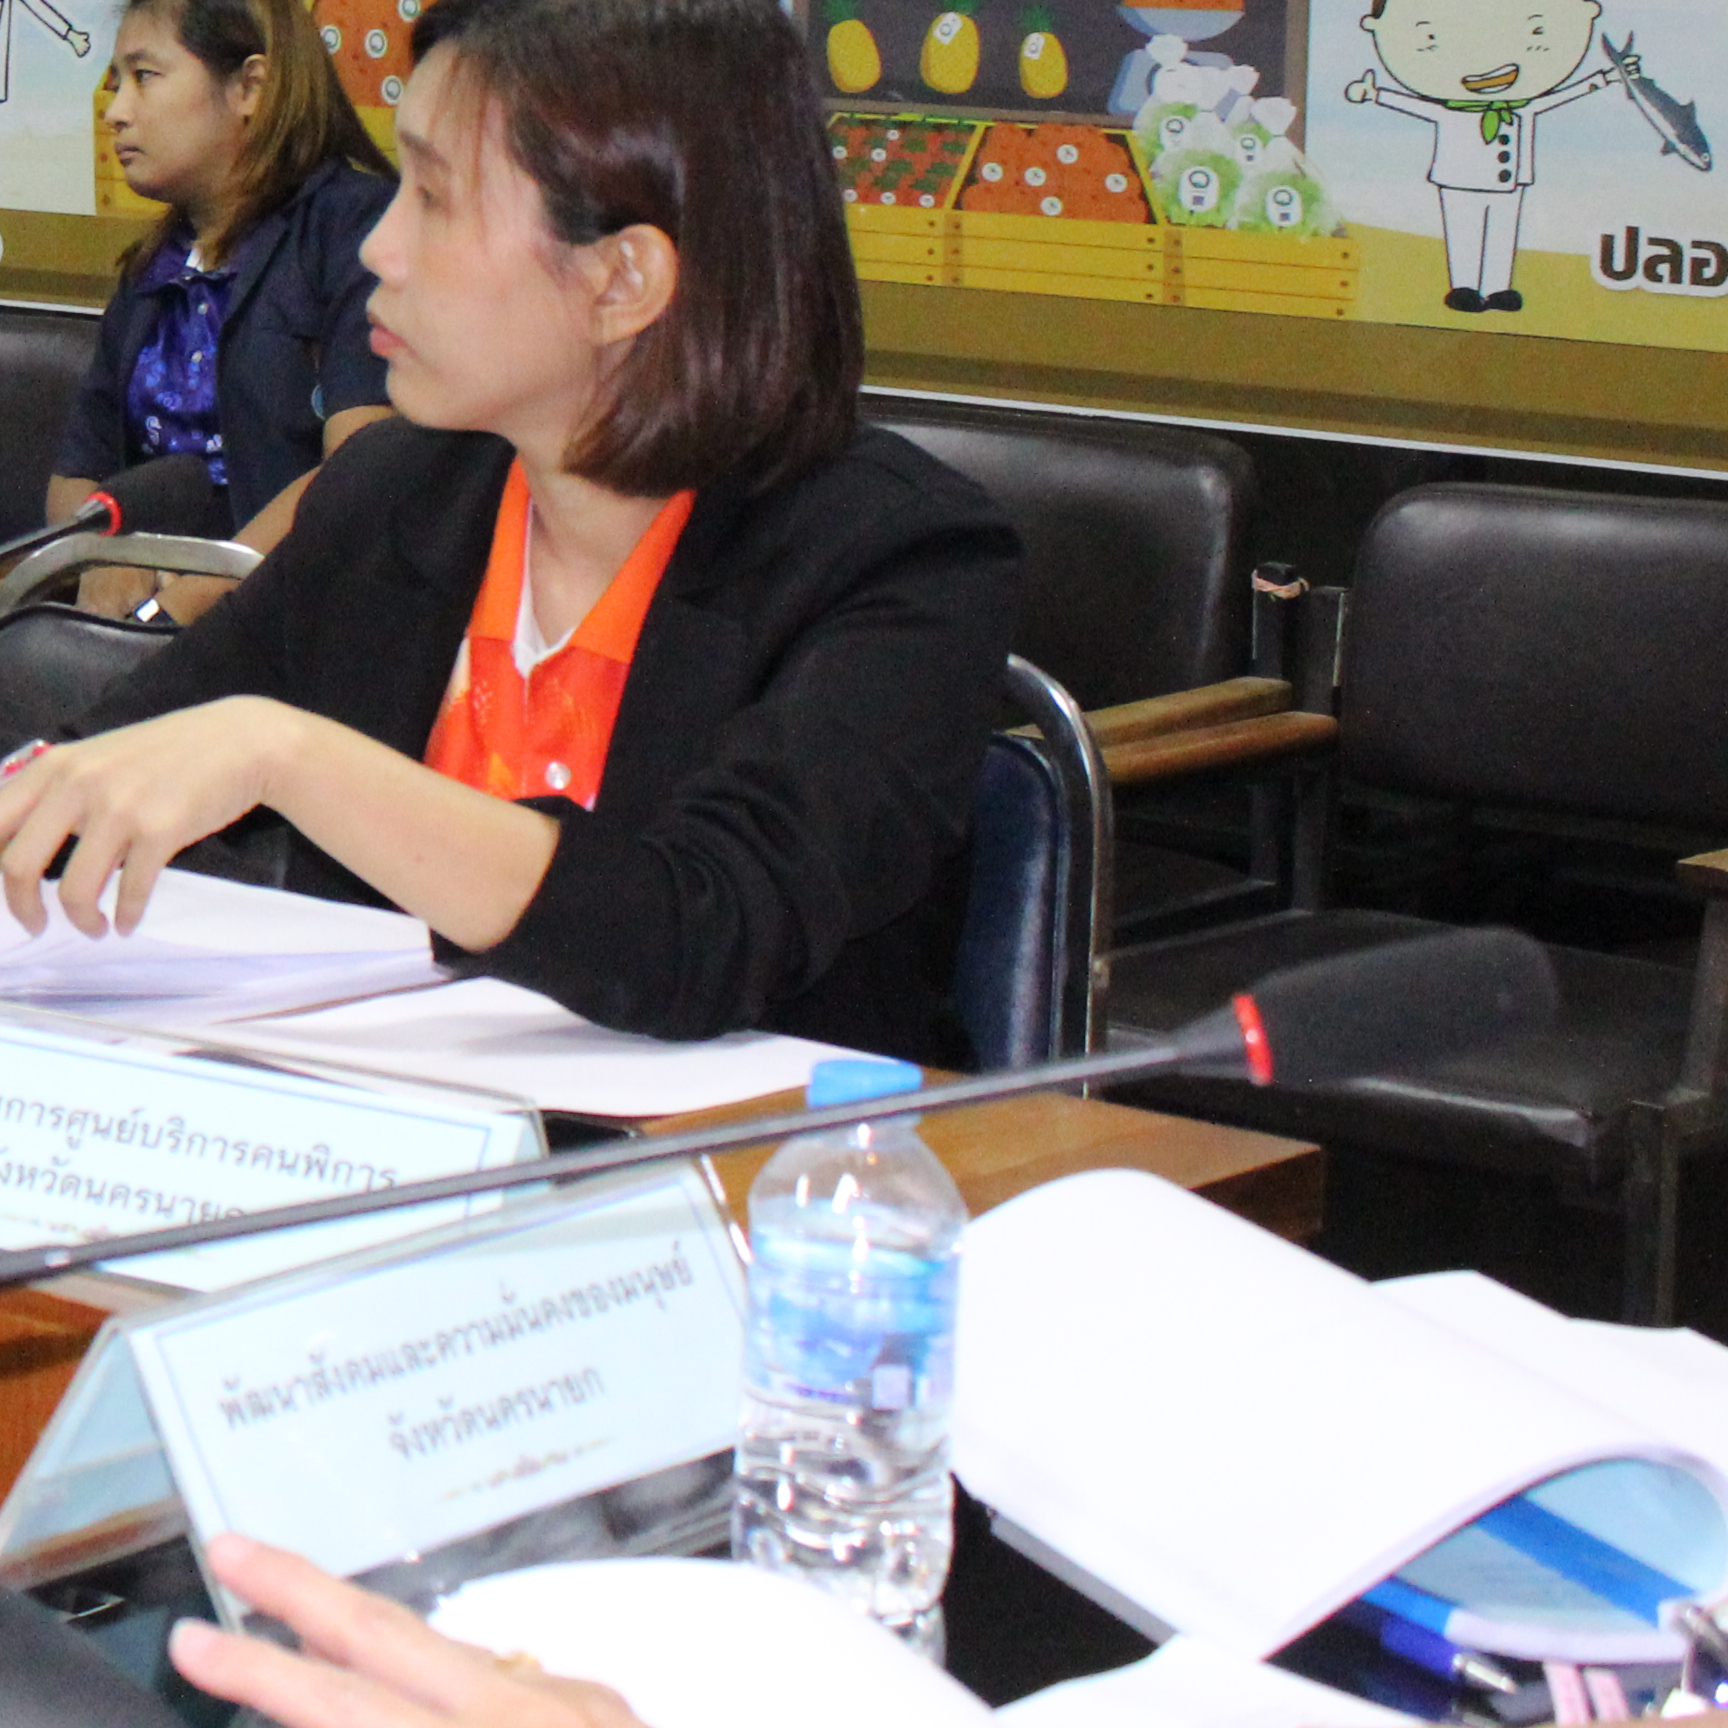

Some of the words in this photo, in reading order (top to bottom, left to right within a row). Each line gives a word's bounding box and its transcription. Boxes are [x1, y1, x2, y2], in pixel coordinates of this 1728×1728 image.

[217, 1238, 696, 1434] พัฒนาสังคมและความมั่นคงของมนุษย์
[386, 1363, 606, 1462] จังหวัดนครนายก
